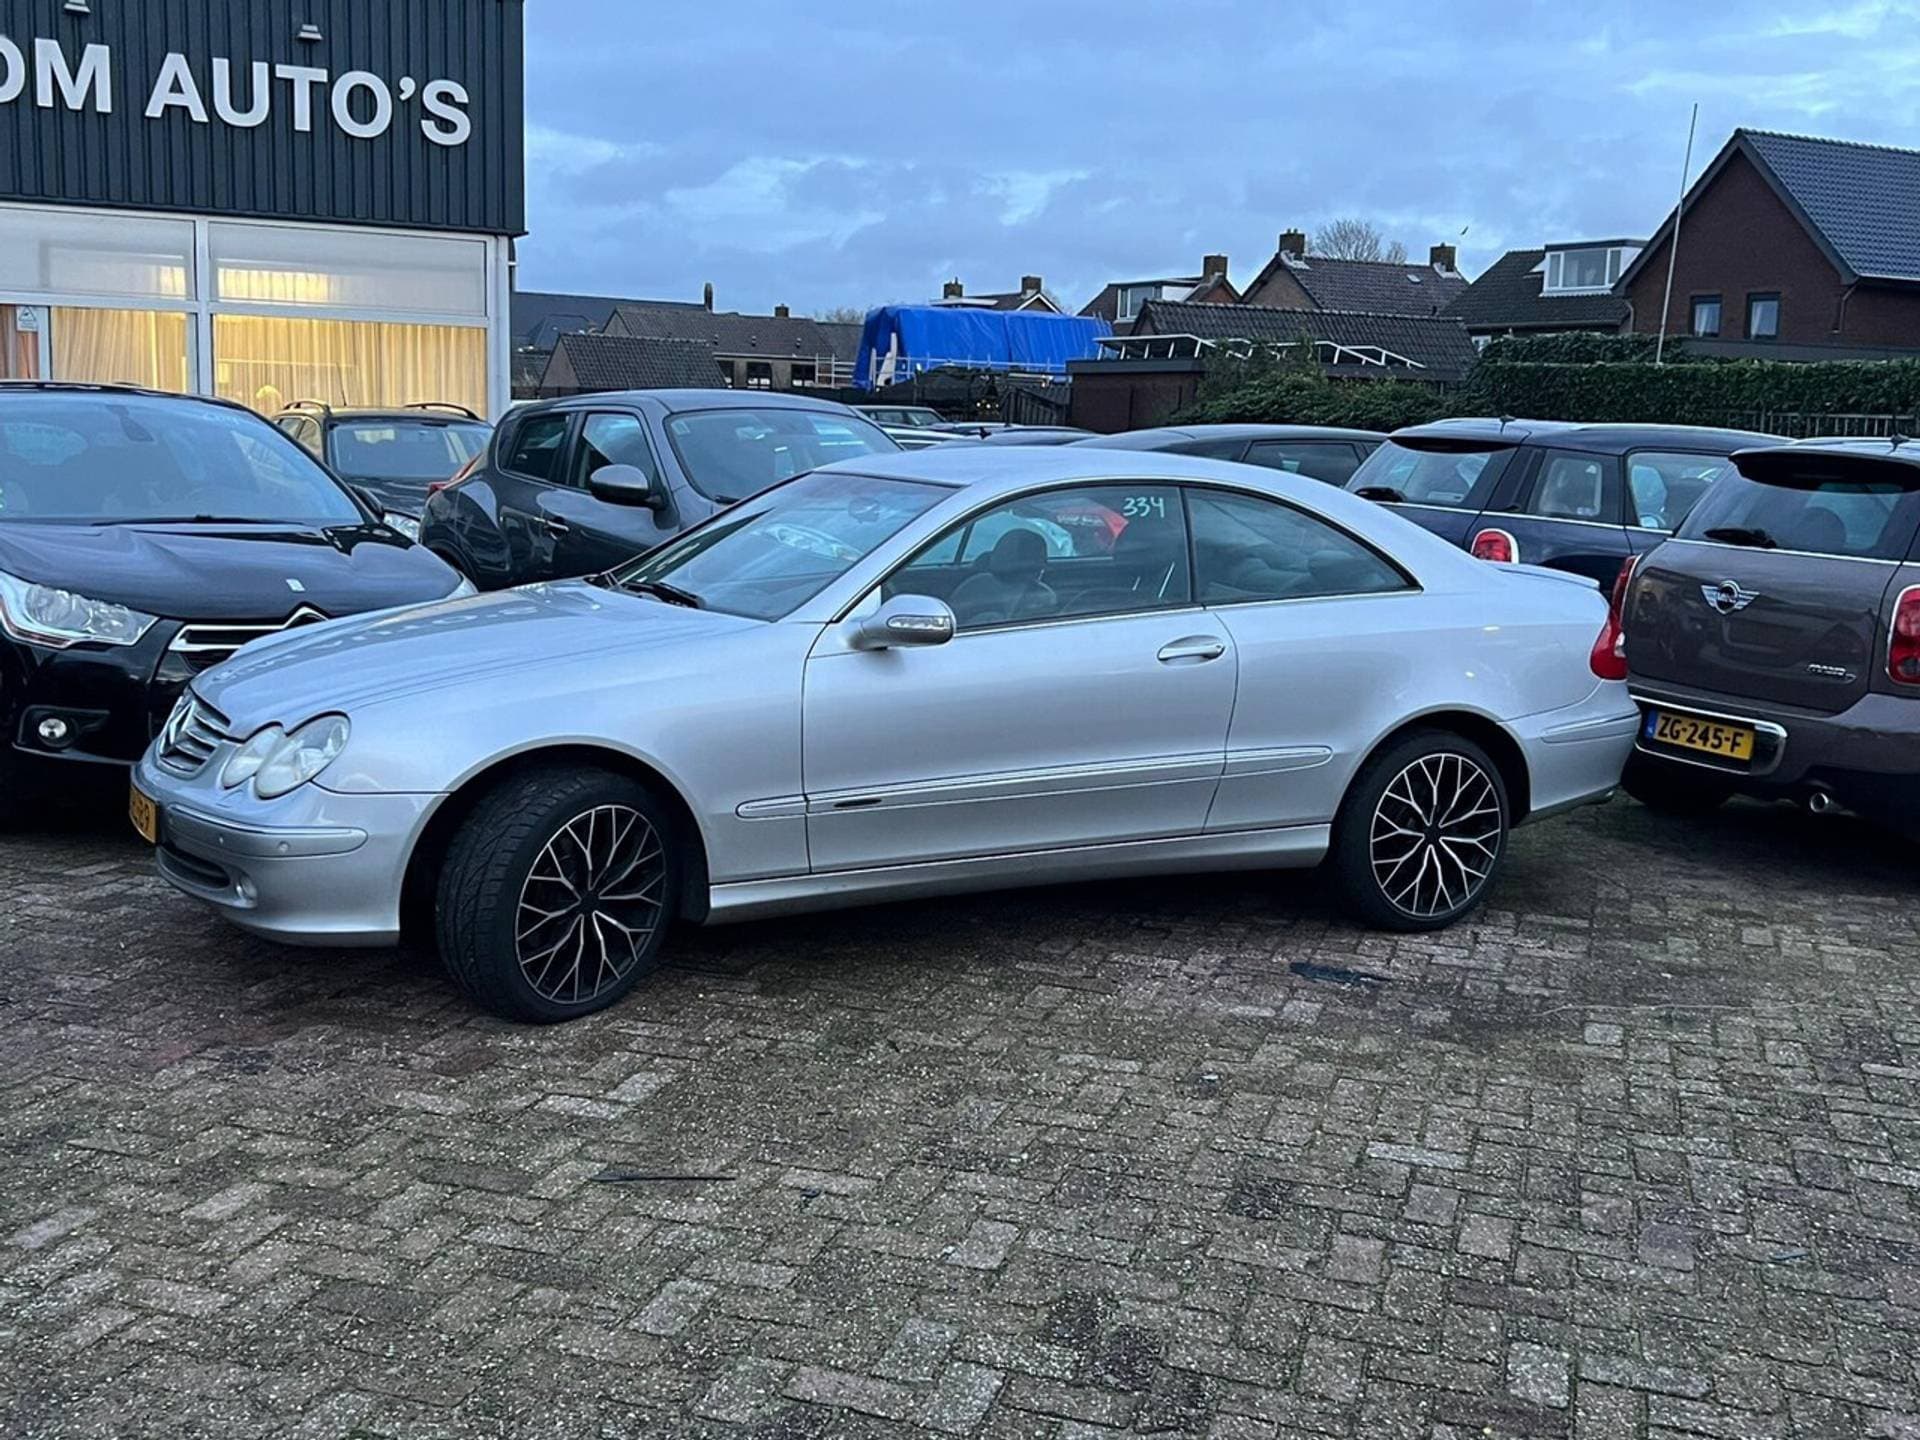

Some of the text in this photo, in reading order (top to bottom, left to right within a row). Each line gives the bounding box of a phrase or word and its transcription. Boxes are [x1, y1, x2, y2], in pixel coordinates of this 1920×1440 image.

[144, 52, 472, 146] AUTO'S
[1122, 496, 1165, 519] 334
[1657, 715, 1744, 753] ZG-245-F
